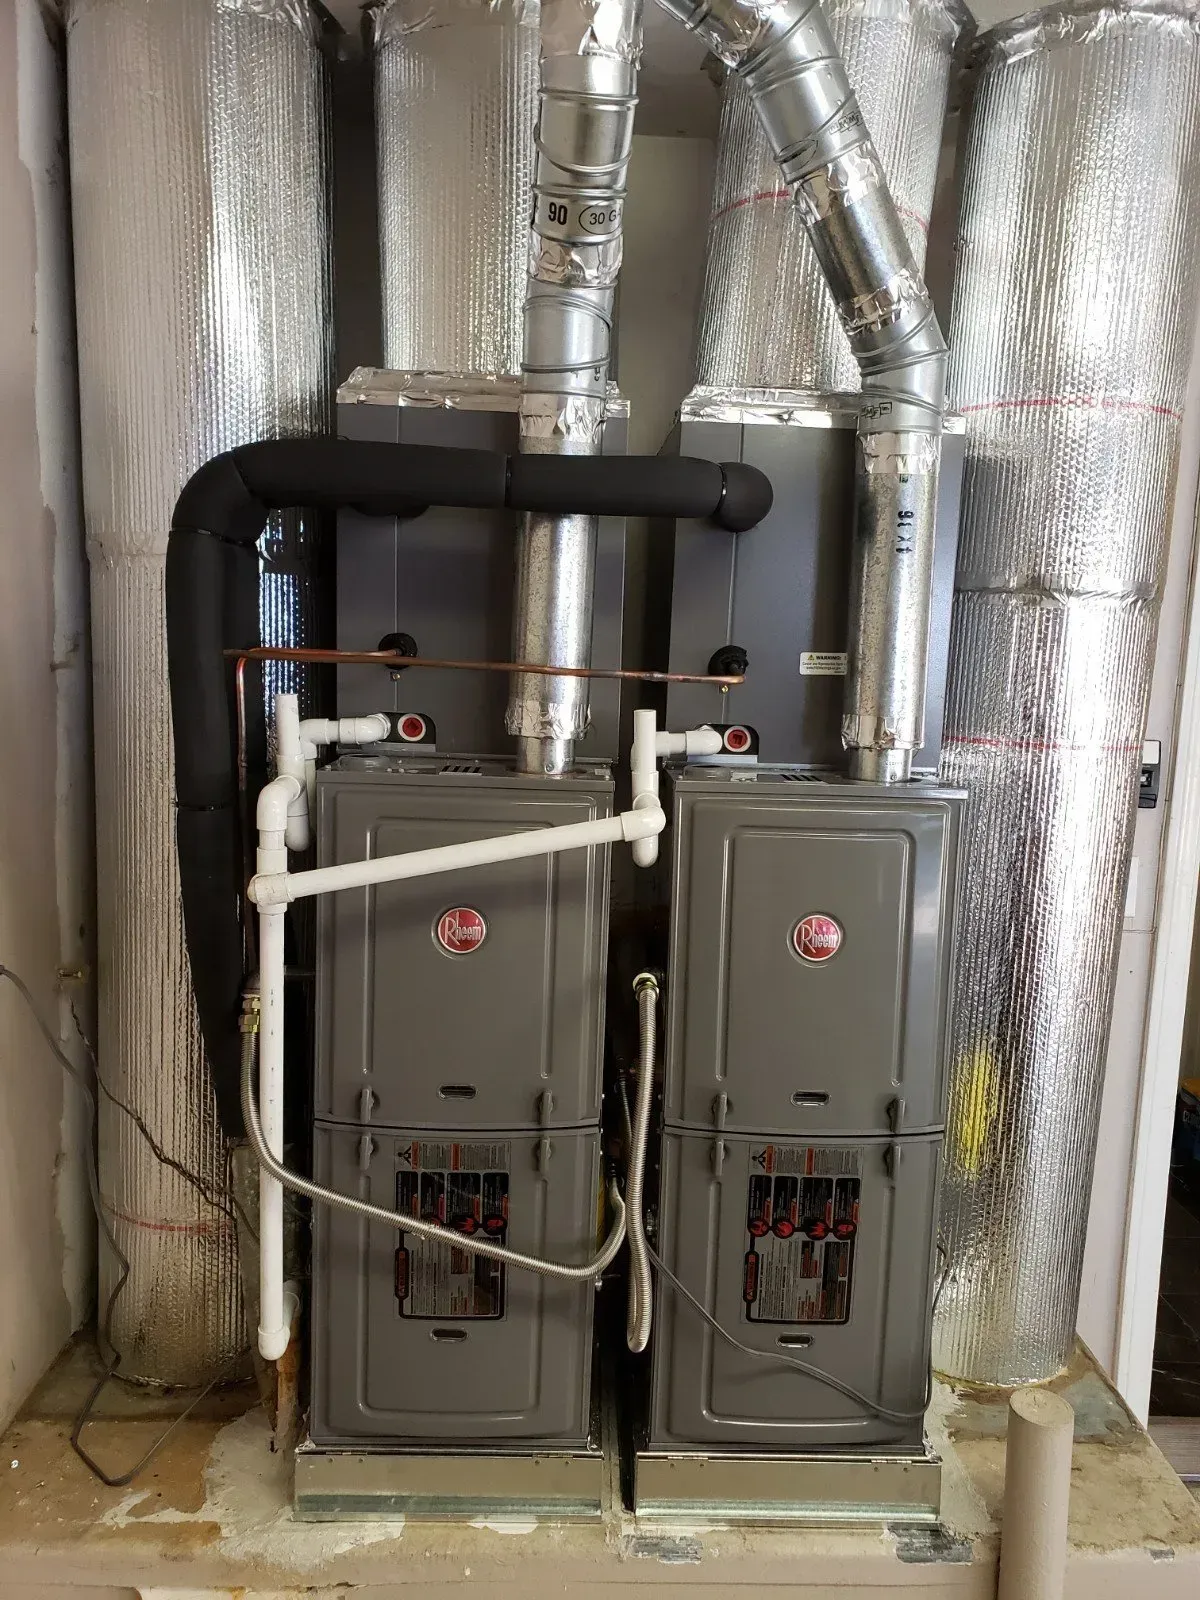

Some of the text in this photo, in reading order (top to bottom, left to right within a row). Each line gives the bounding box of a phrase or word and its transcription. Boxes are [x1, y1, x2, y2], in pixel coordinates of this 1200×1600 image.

[548, 202, 567, 226] 90
[589, 212, 606, 226] 30
[444, 910, 482, 946] Rheem
[800, 919, 839, 954] Rheem
